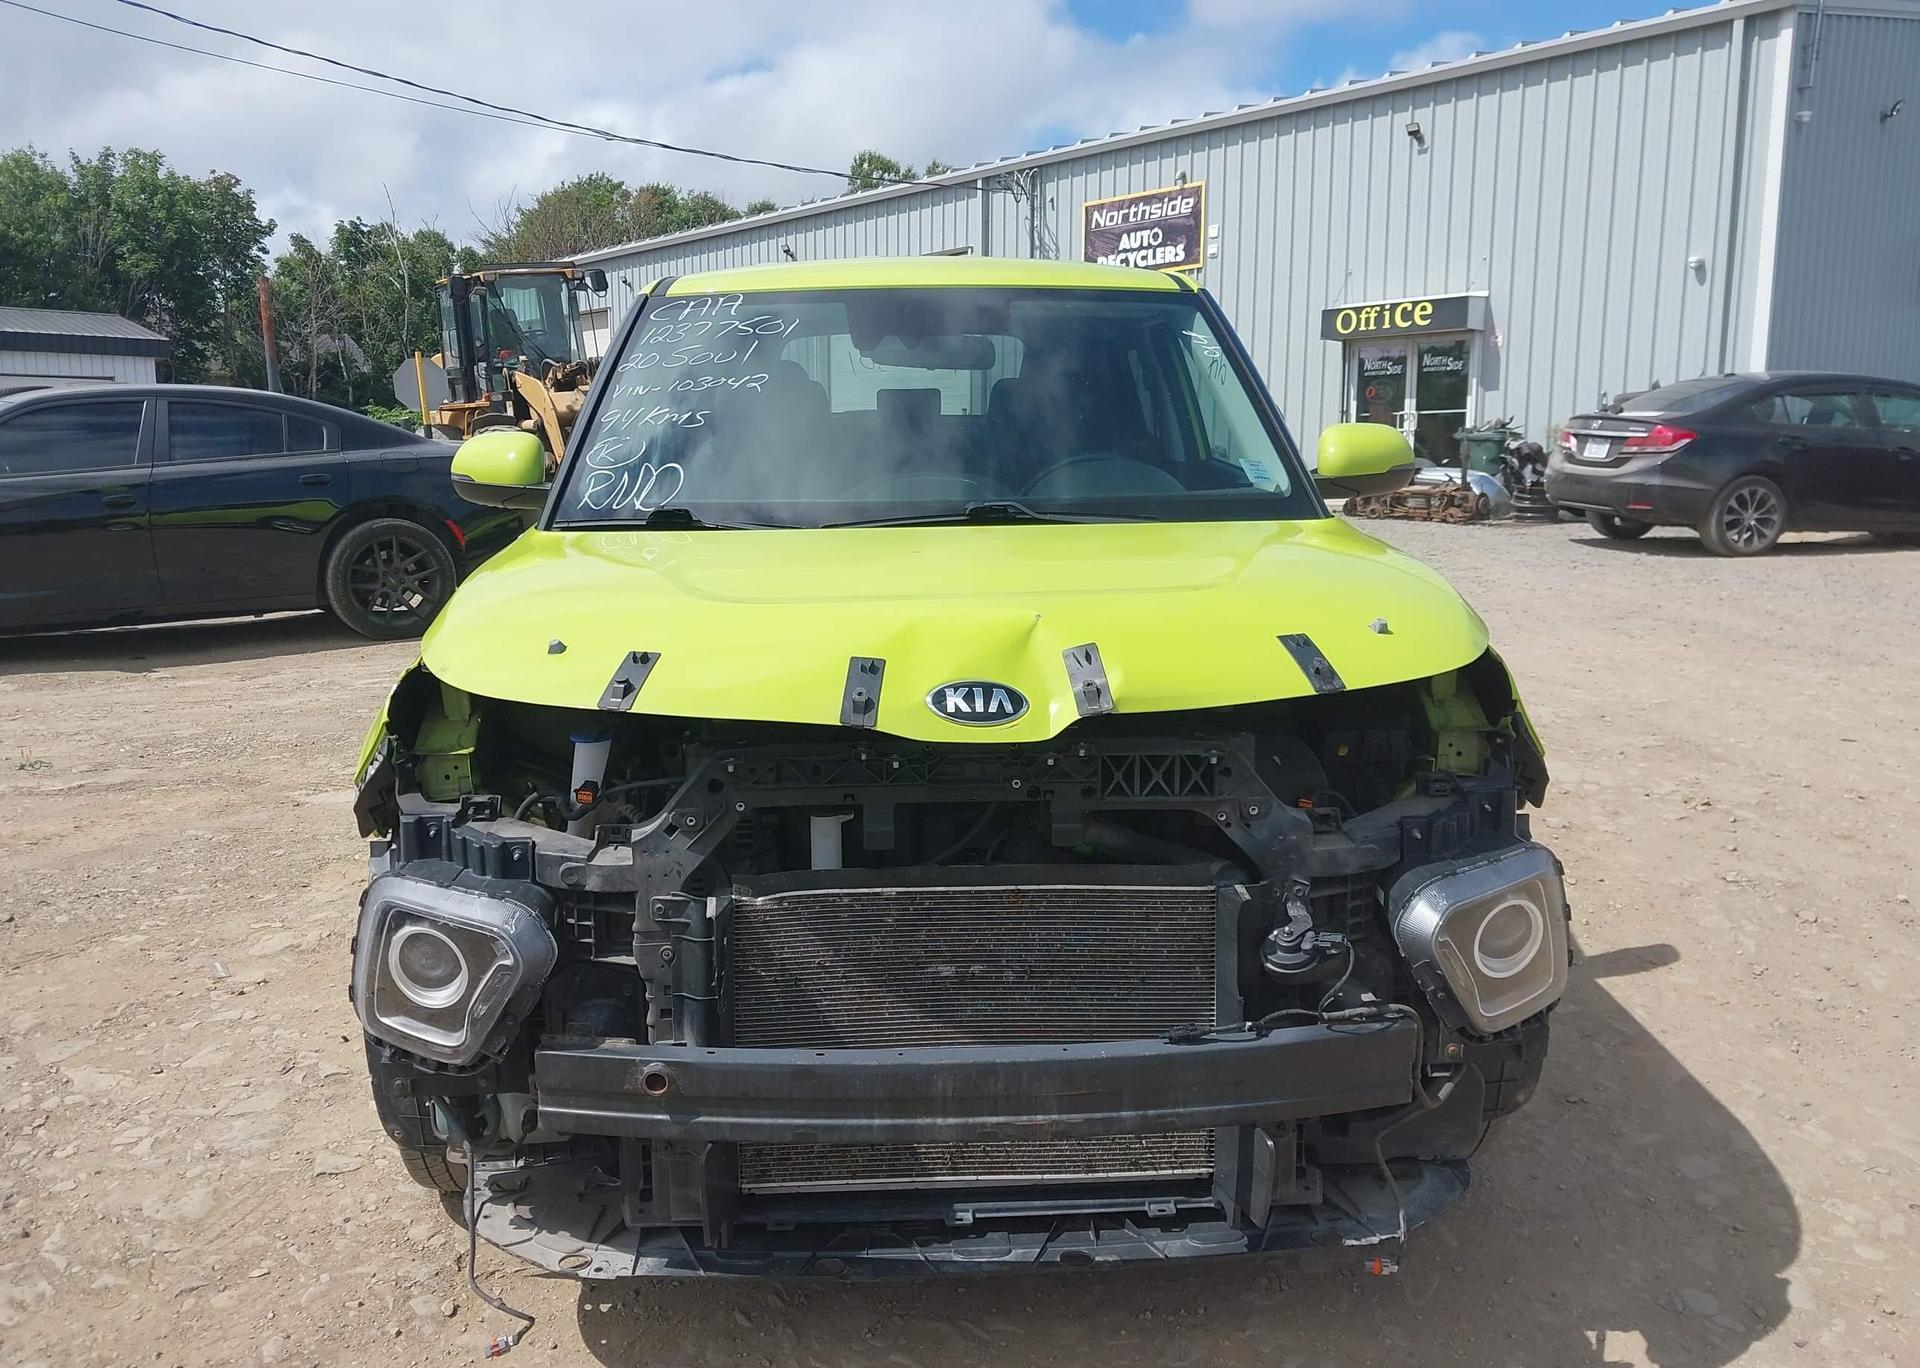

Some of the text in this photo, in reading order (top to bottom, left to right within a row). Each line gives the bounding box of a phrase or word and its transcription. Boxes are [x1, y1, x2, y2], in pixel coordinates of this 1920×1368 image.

[1091, 196, 1194, 229] Northside
[1118, 227, 1163, 251] AUTO
[1336, 301, 1433, 335] Office
[945, 687, 1014, 713] KIA
